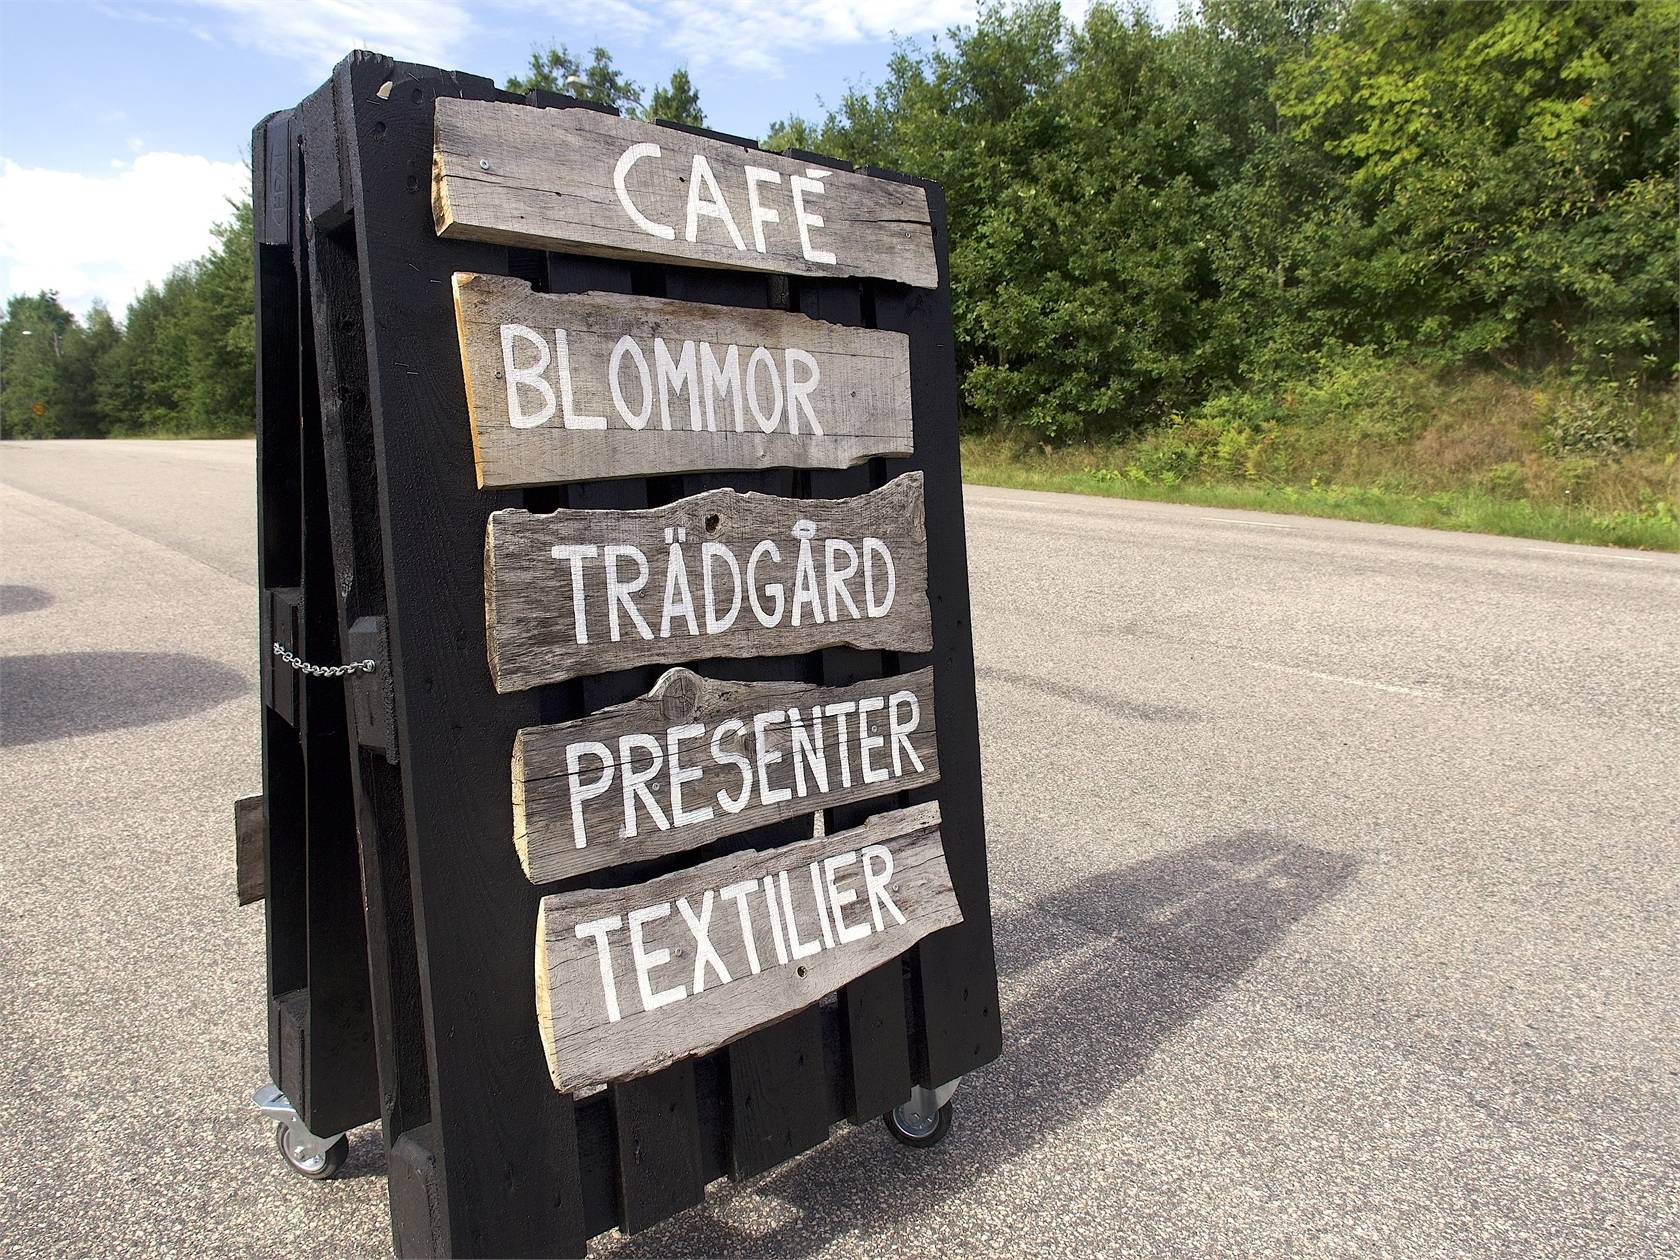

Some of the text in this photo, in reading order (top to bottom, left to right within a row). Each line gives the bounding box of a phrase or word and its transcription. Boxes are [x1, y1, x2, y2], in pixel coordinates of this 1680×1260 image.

[613, 142, 837, 264] CAFÉ
[500, 323, 824, 436] BLOMMOR
[551, 519, 897, 645] TRÄDGÅRD
[565, 690, 925, 849] PRESENTER
[574, 844, 907, 1023] TEXTILIER
